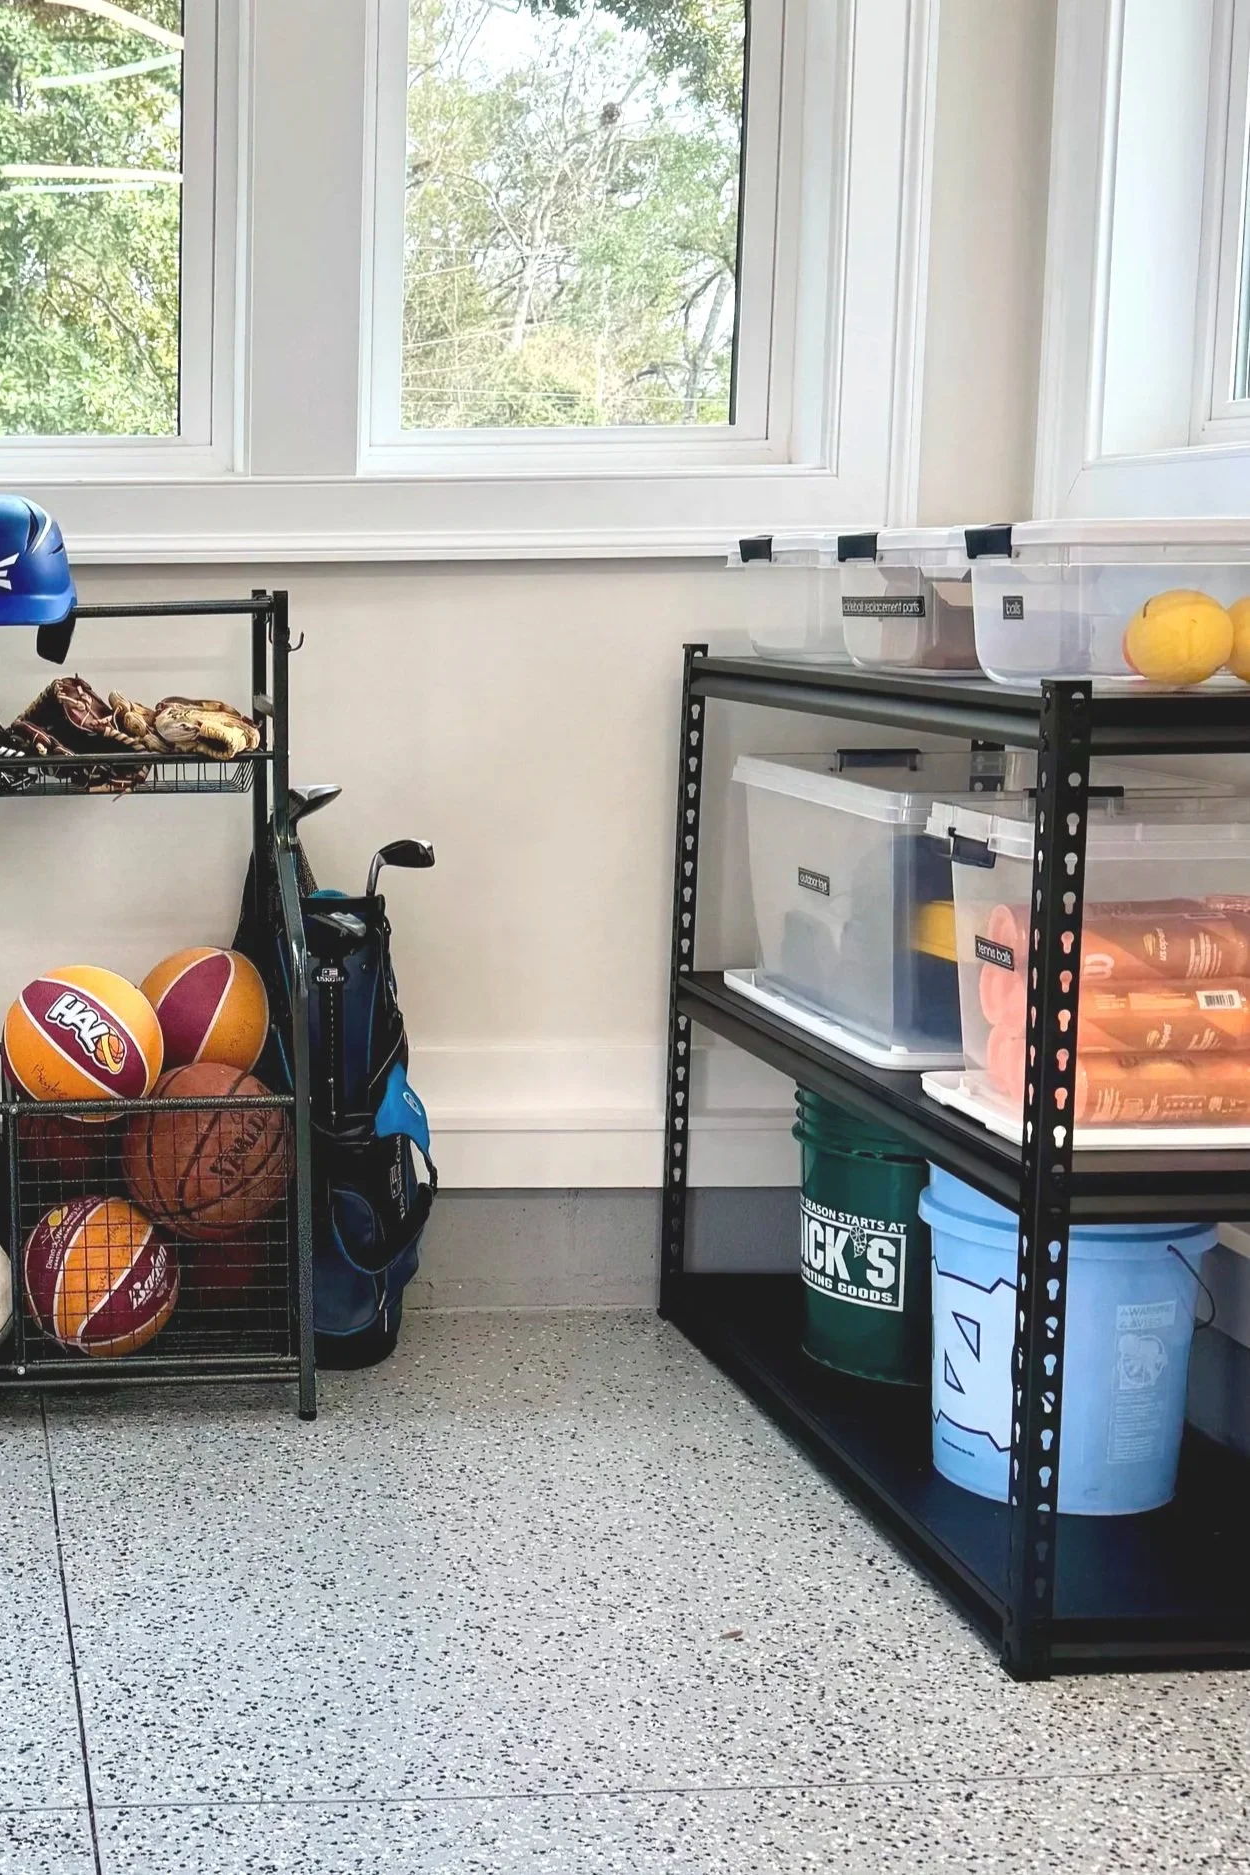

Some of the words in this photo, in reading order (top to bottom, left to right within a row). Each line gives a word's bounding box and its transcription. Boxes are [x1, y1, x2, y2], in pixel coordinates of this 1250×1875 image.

[865, 602, 902, 612] replacement
[903, 602, 920, 613] parts
[1005, 600, 1022, 616] balls
[977, 942, 996, 959] tennis
[996, 948, 1012, 965] balls
[805, 1198, 836, 1220] SEASON
[837, 1212, 886, 1231] STARTS
[887, 1222, 907, 1234] AT
[801, 1209, 897, 1289] ICK'S
